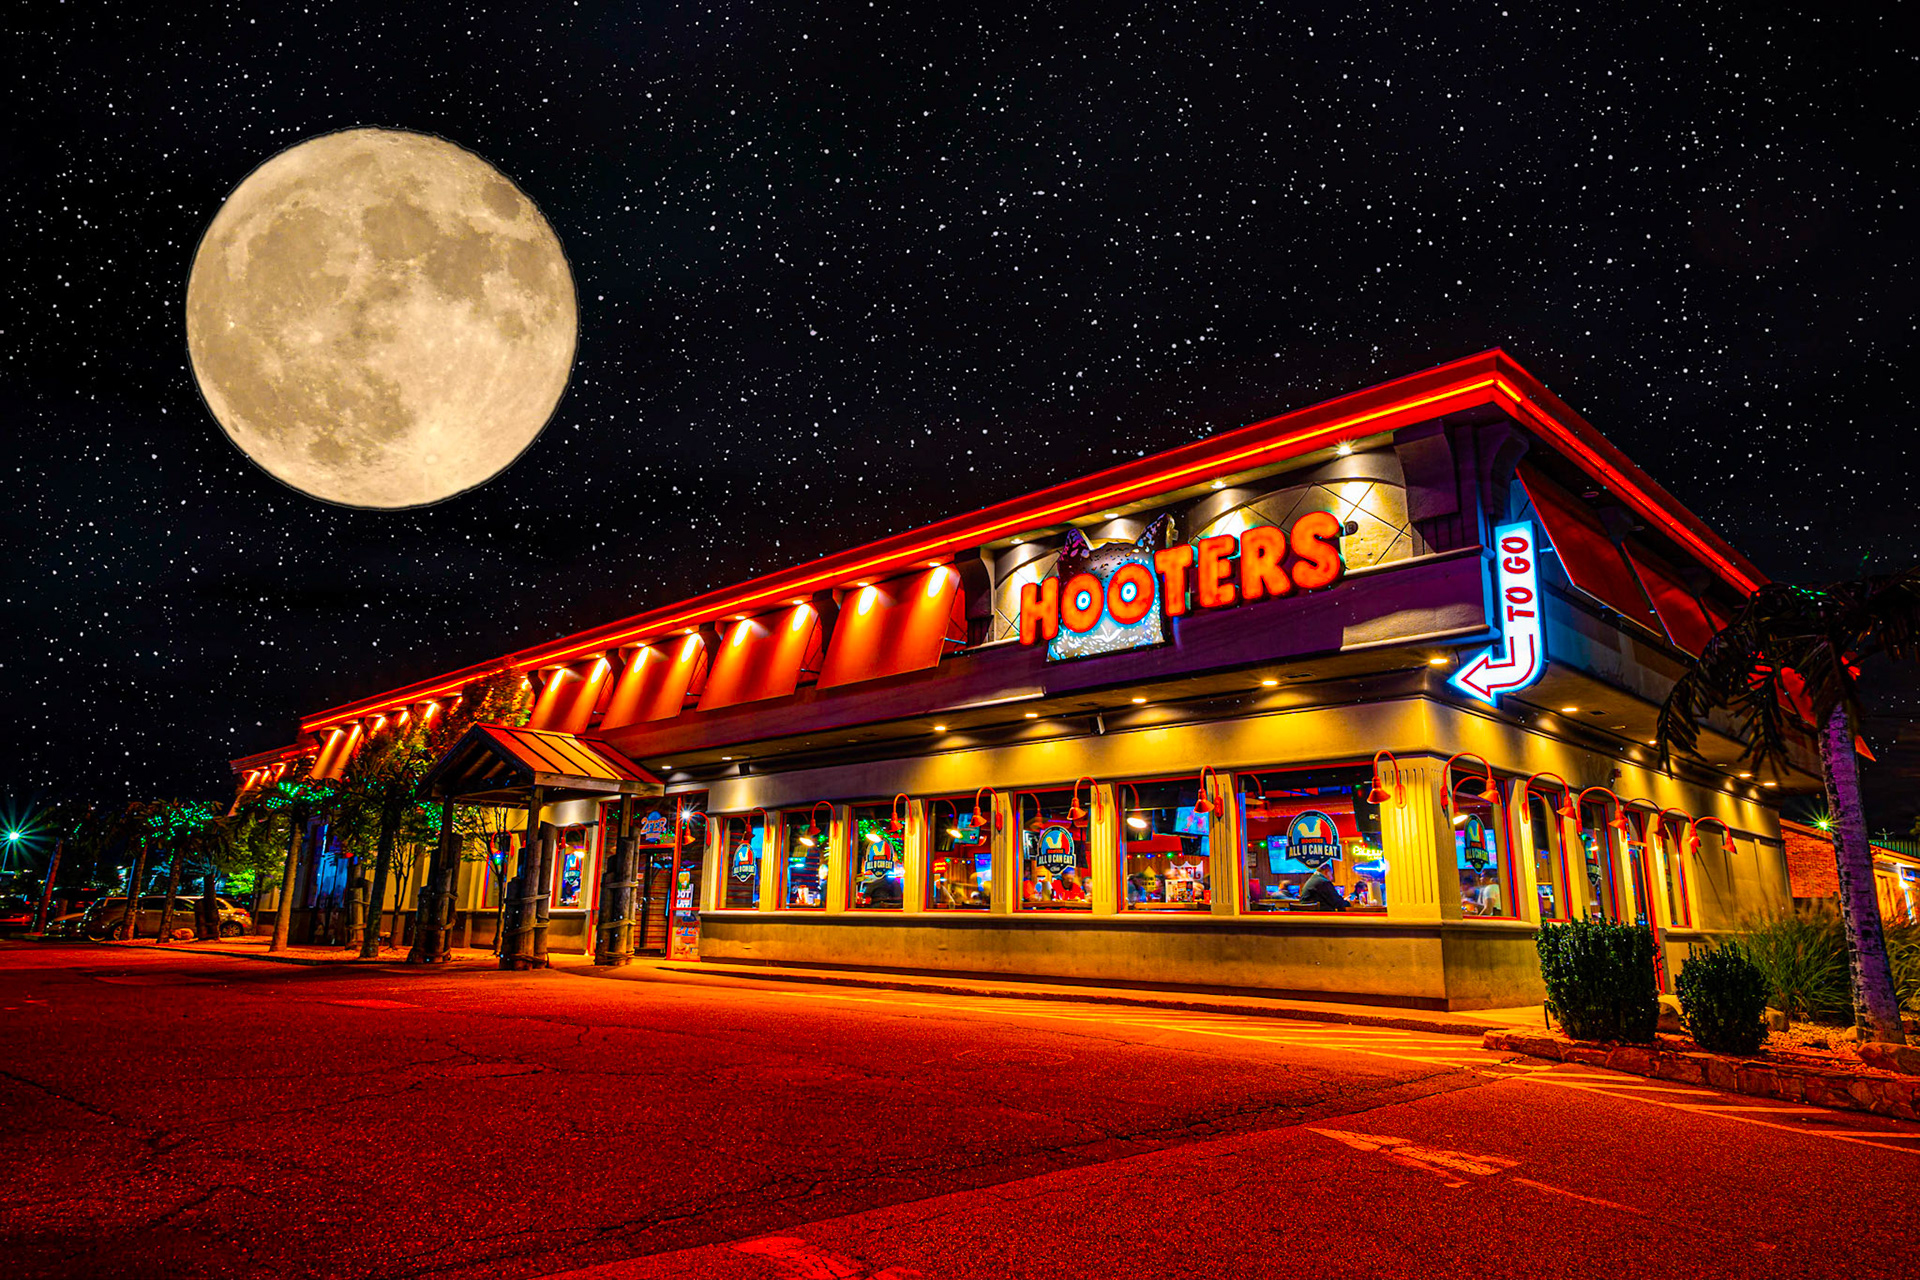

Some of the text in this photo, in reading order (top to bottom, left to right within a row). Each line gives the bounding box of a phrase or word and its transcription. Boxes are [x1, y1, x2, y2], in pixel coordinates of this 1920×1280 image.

[1019, 511, 1343, 645] HOOTERS
[1501, 537, 1534, 622] TO GO
[1289, 844, 1338, 857] ALL U CAN EAT
